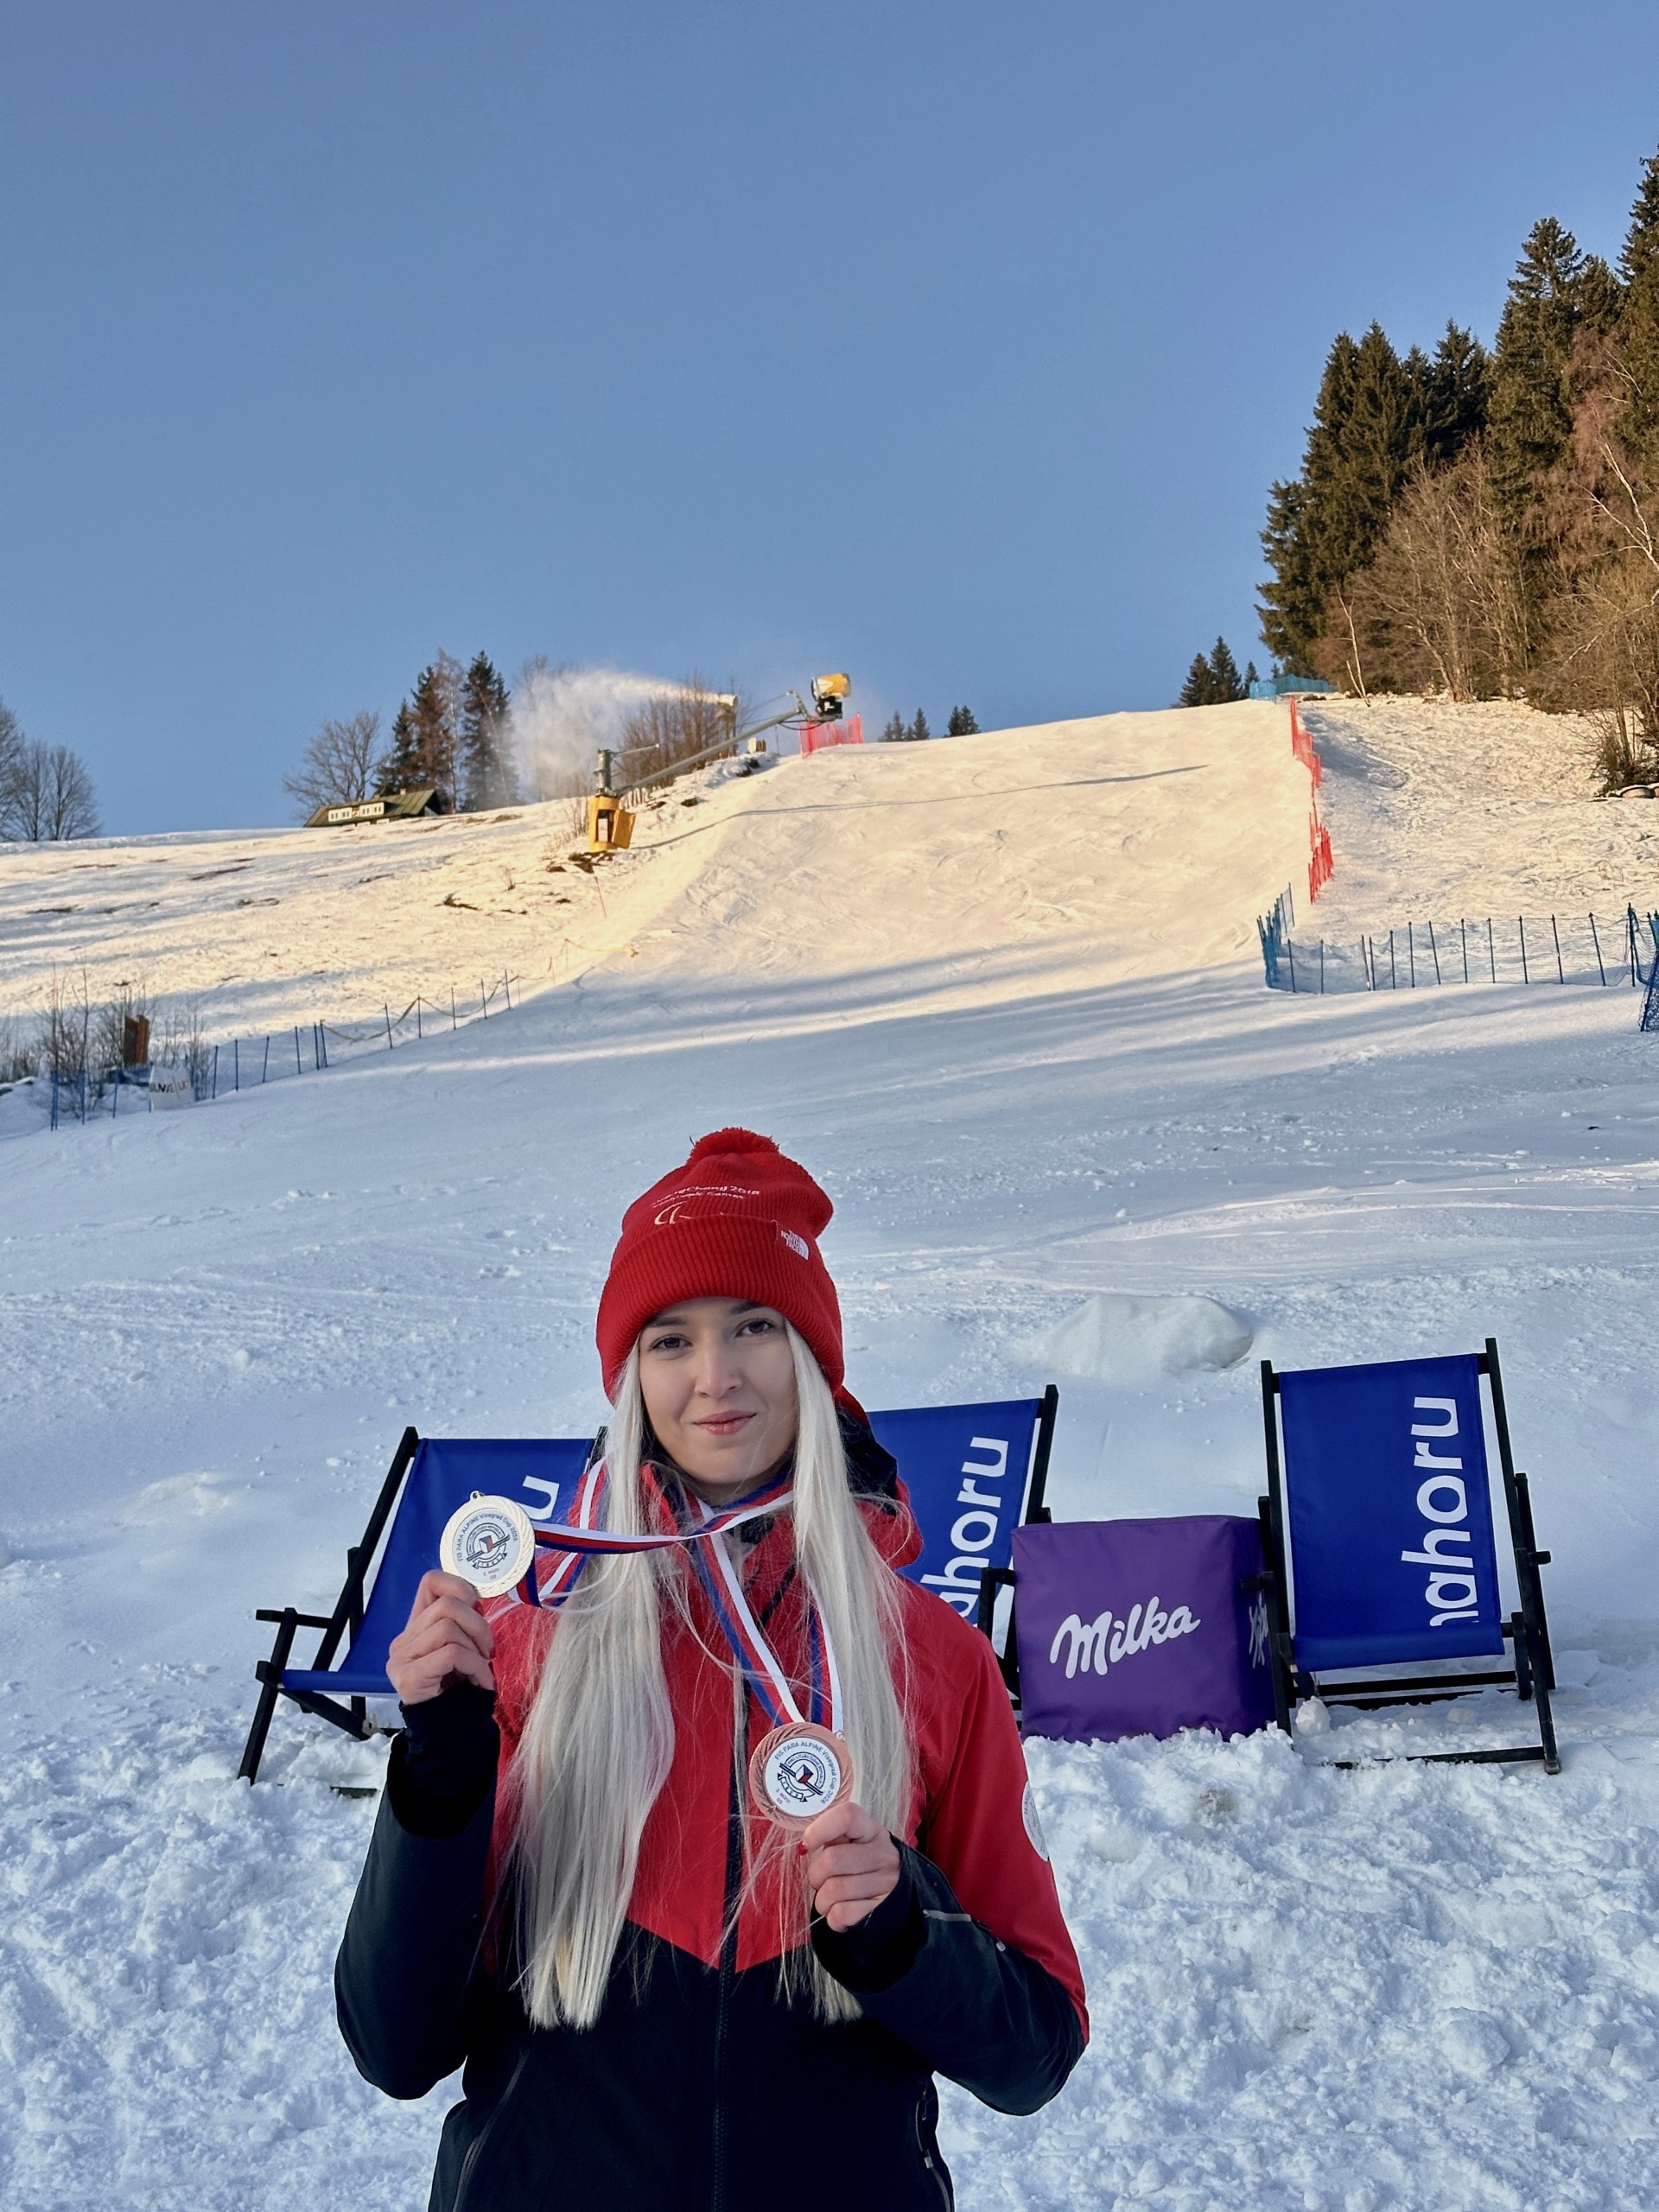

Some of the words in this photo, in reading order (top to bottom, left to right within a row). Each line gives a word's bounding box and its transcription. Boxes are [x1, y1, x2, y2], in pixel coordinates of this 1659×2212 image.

[503, 1517, 512, 1528] Cup
[1049, 1595, 1202, 1679] Milka
[774, 1751, 784, 1760] FIS
[800, 1741, 823, 1752] ALPINE
